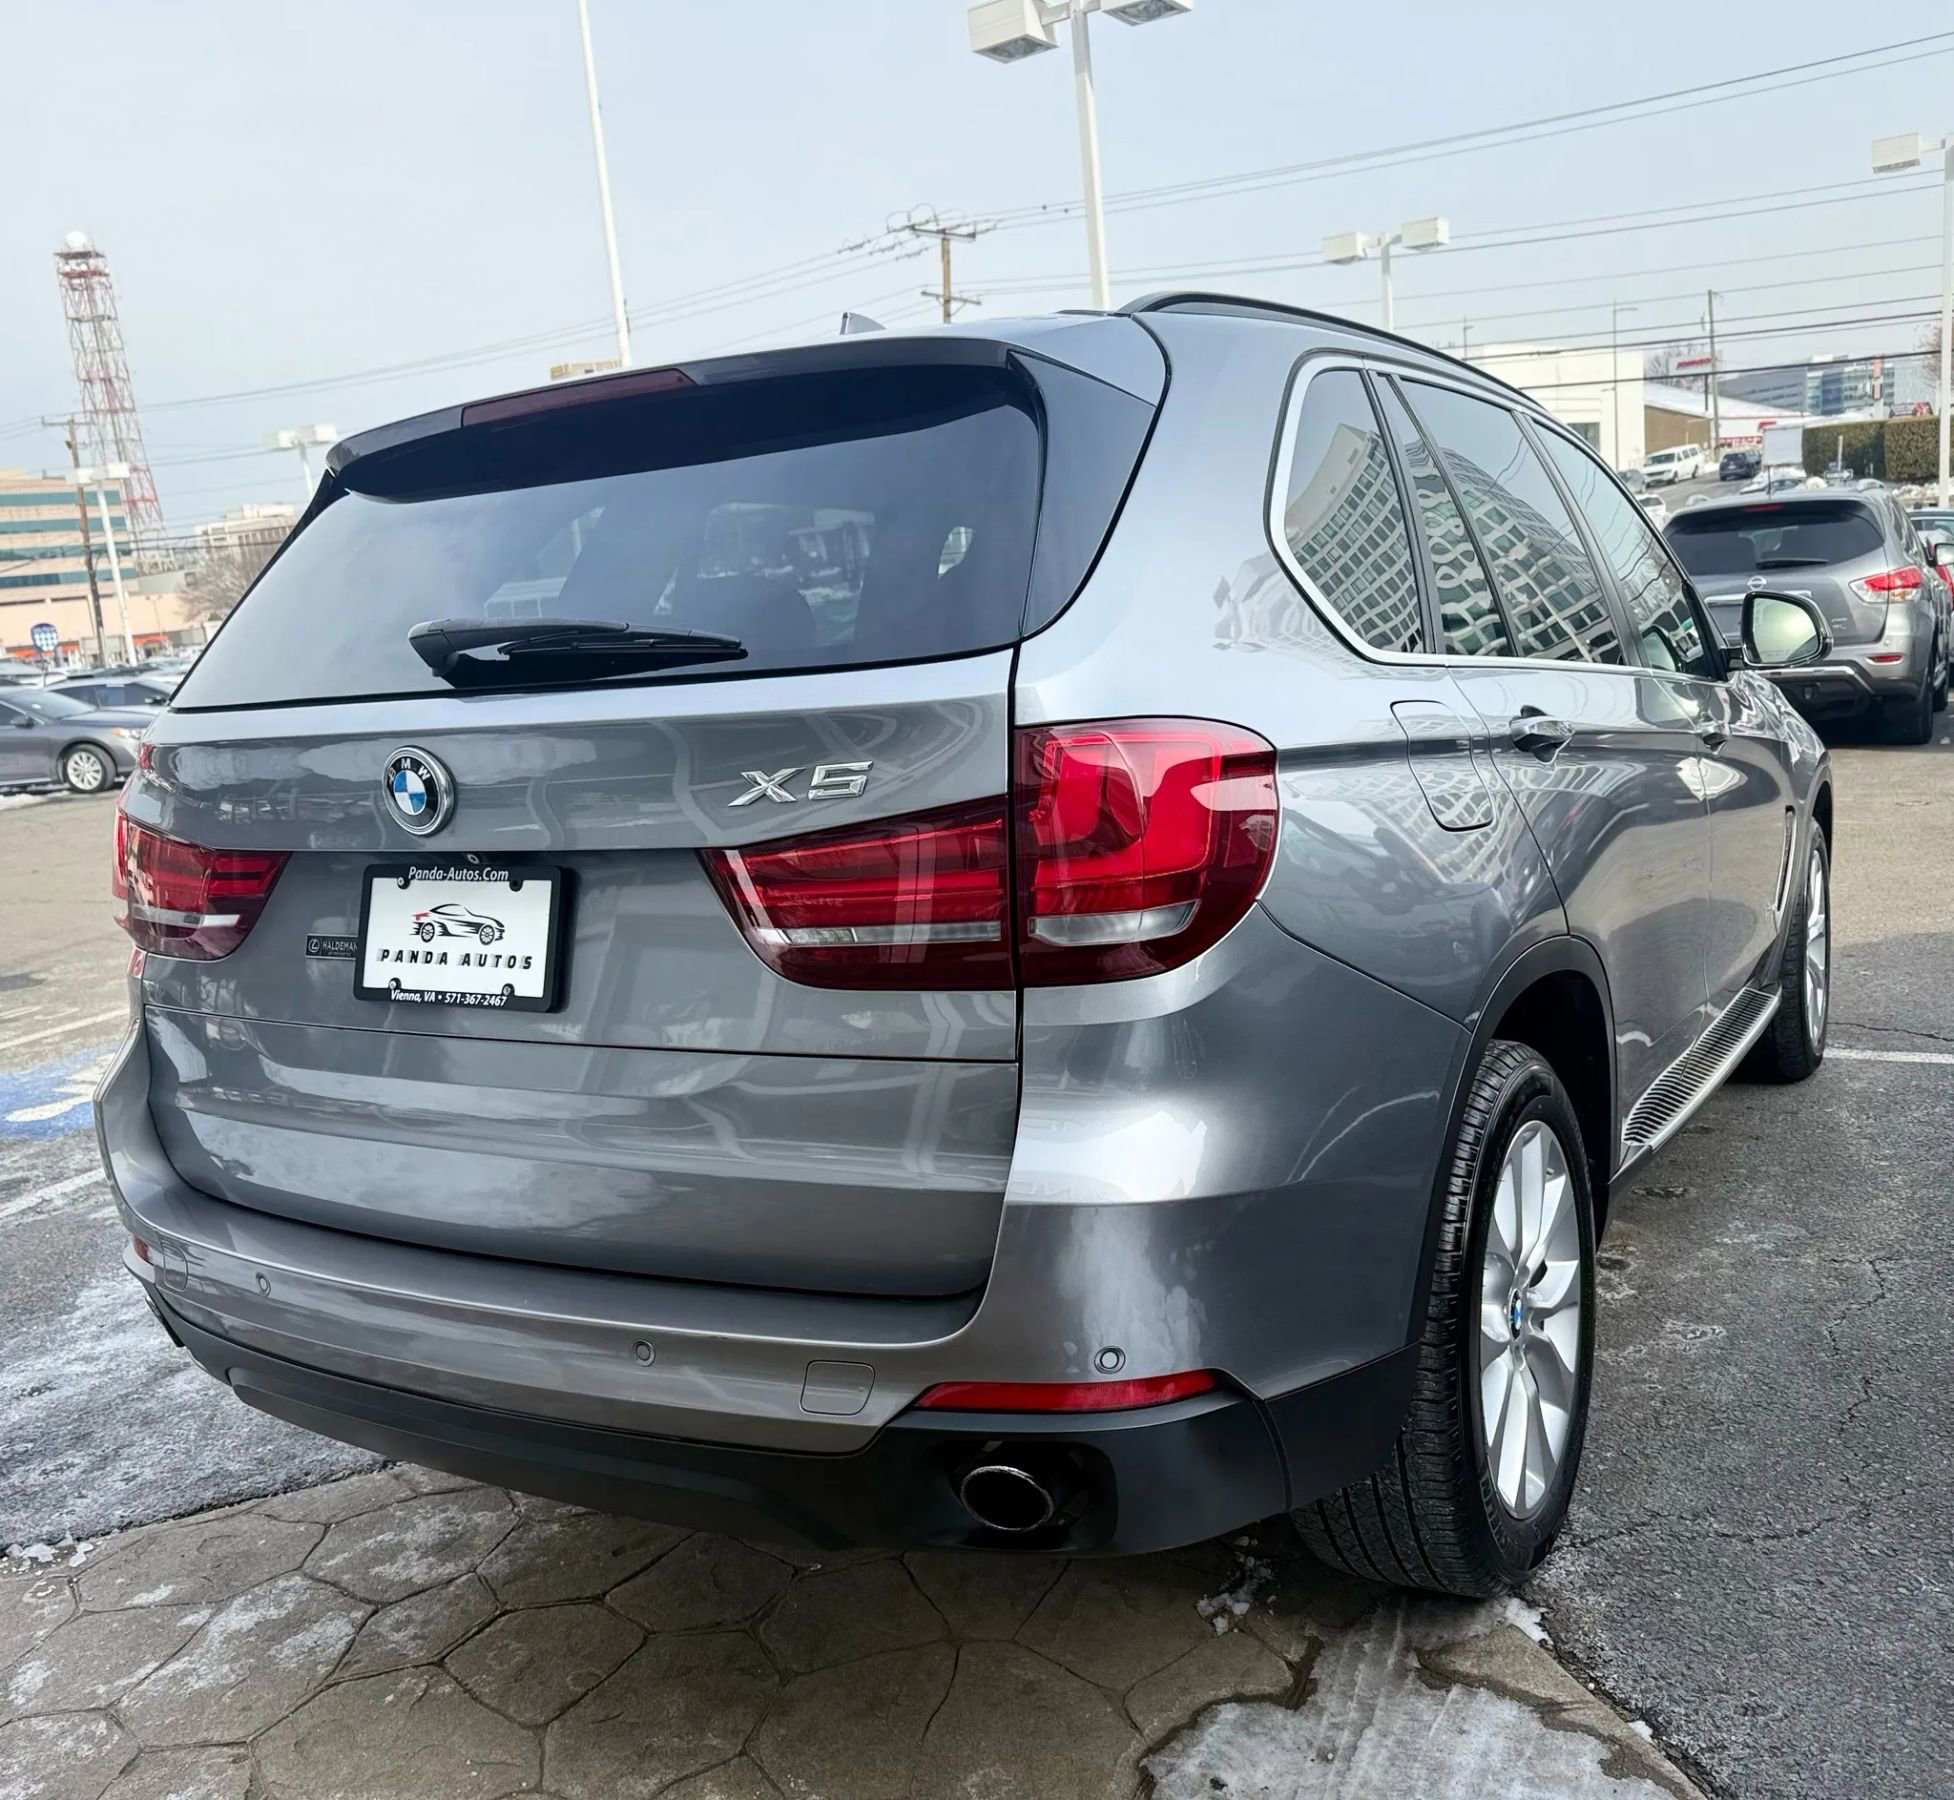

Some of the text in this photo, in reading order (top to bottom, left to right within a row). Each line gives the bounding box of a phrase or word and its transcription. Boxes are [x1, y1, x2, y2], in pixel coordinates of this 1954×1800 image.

[388, 757, 431, 785] BMW
[728, 761, 873, 807] X5
[408, 866, 509, 881] Panda-Autos.Com
[379, 949, 532, 970] PANDA AUTOS
[391, 989, 507, 1007] Vienna, VA 571-367-2467
